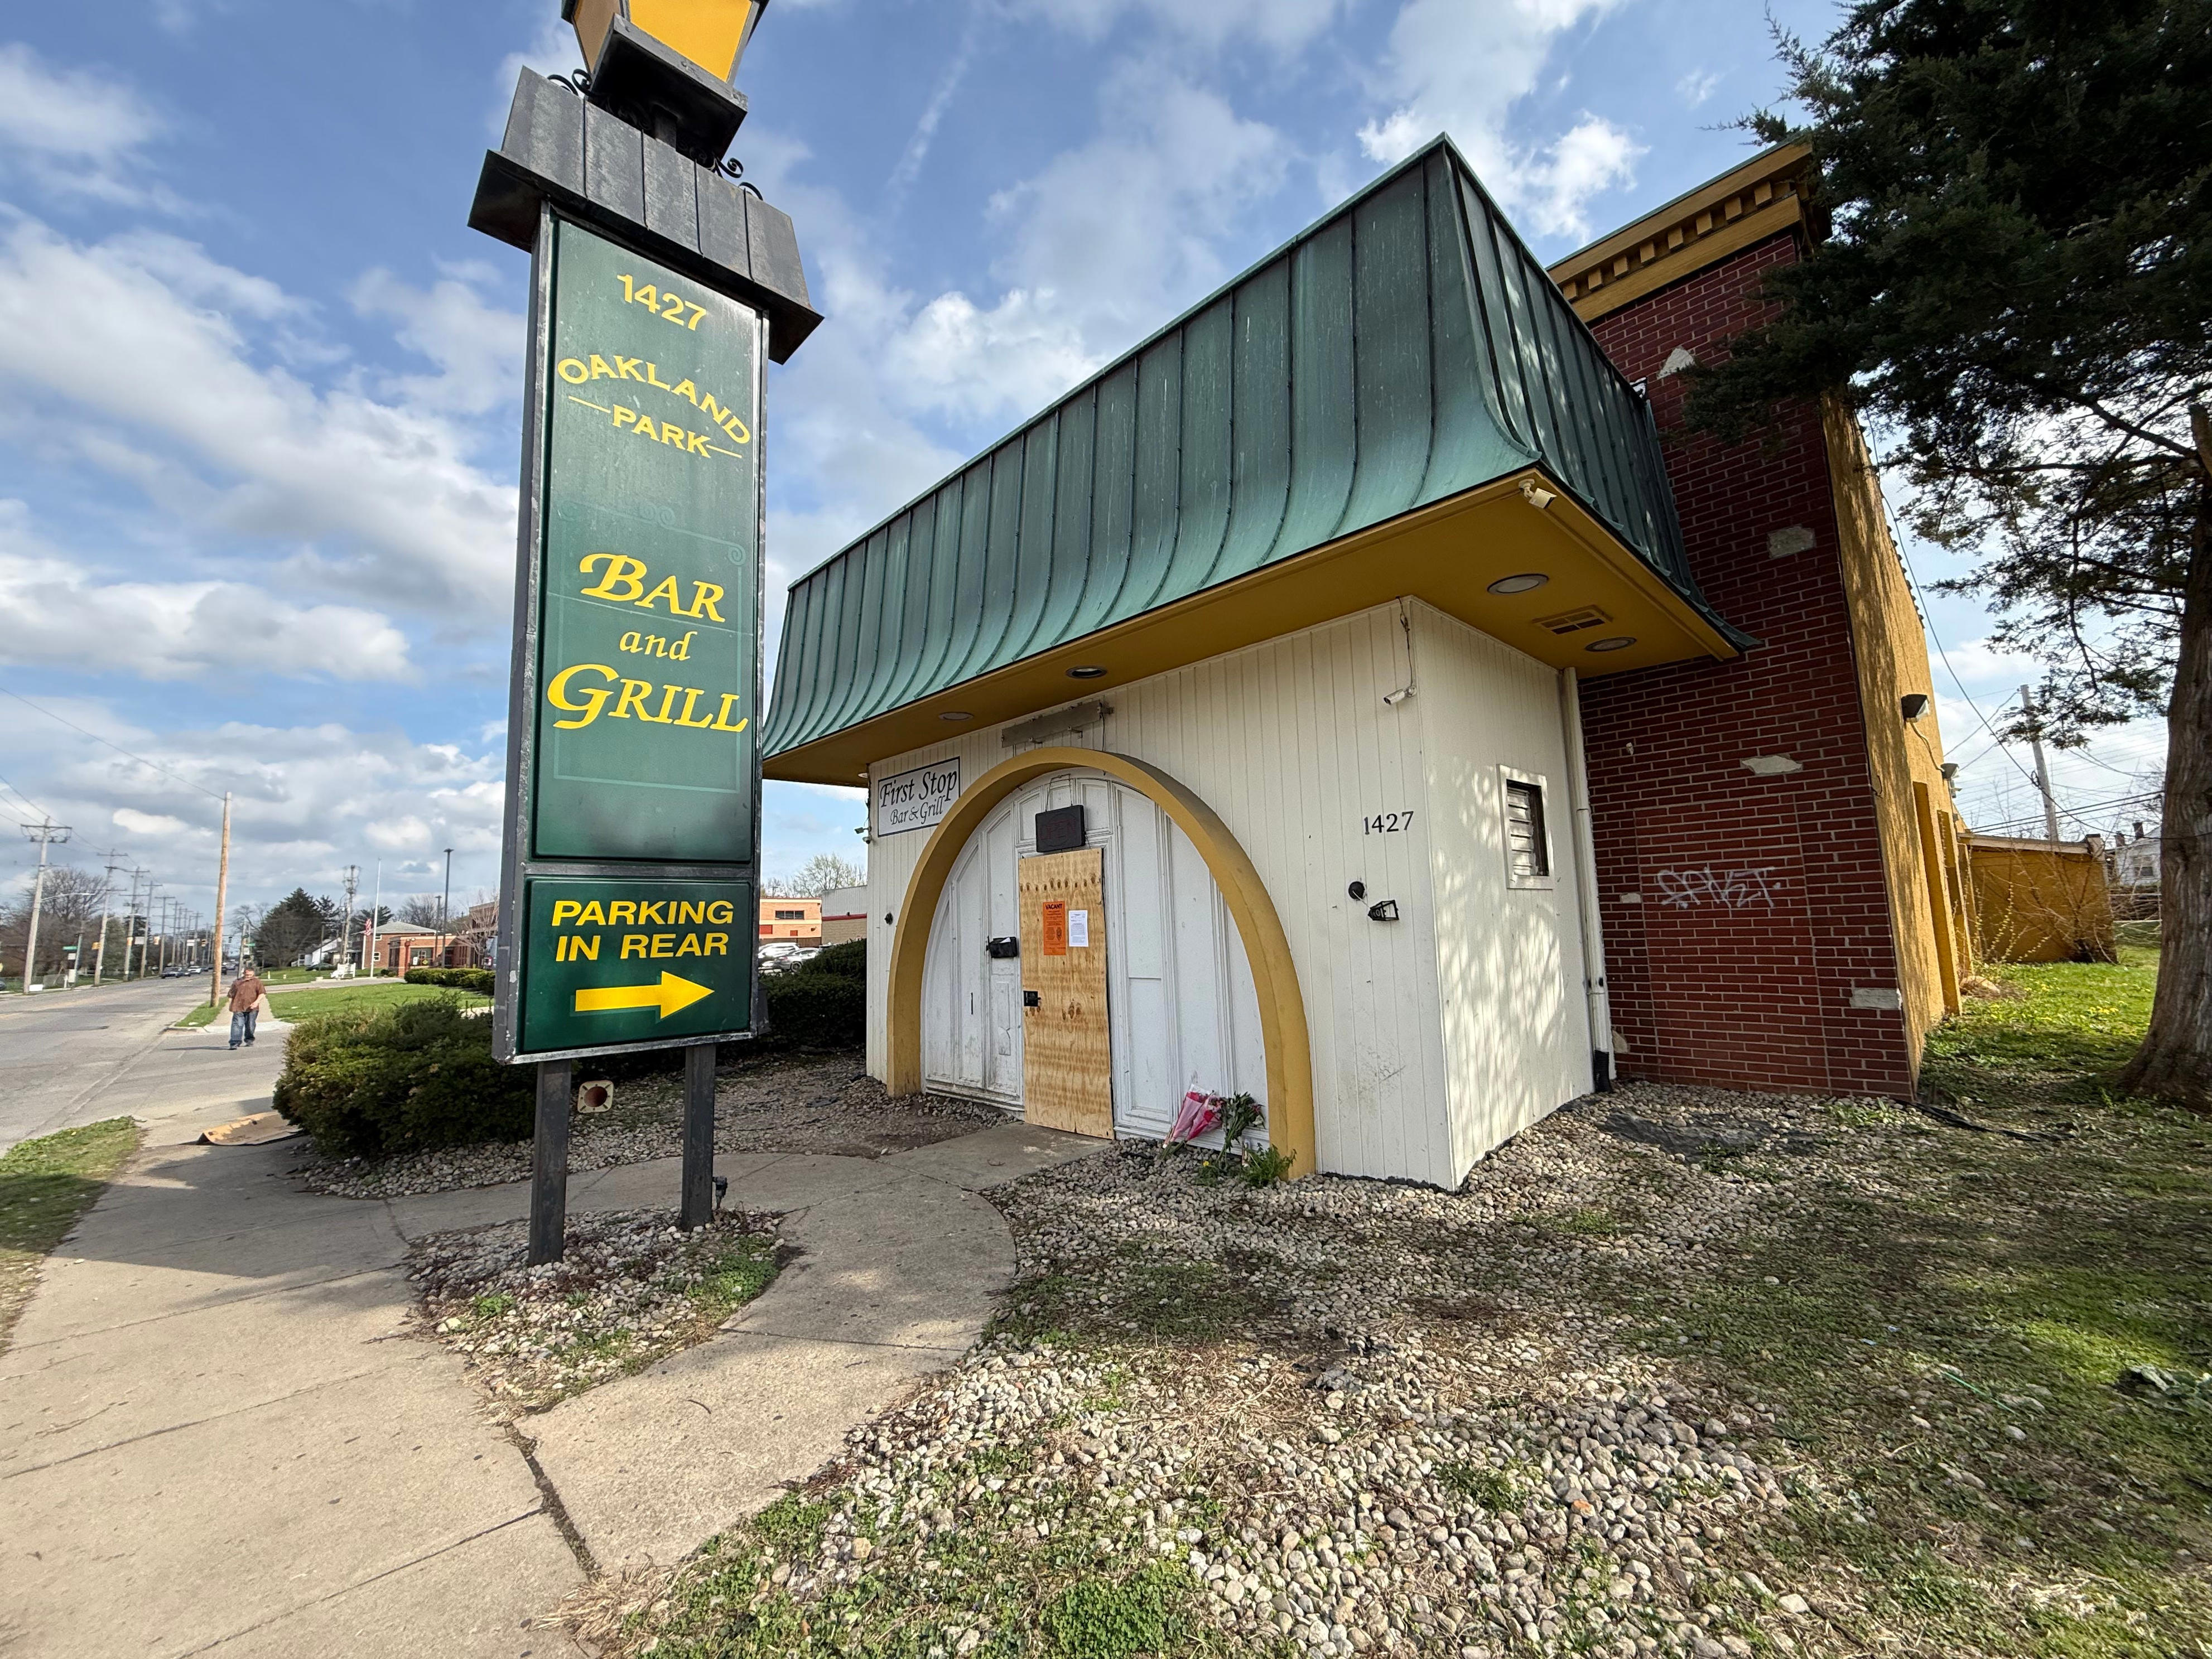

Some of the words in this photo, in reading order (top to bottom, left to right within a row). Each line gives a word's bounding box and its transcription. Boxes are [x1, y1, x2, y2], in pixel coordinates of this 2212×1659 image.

[617, 273, 706, 331] 1427
[558, 354, 750, 444] OAKLAND
[612, 404, 711, 458] PARK
[579, 553, 725, 623] BAR
[619, 631, 697, 661] and
[547, 664, 749, 732] GRILL
[880, 779, 914, 808] First
[918, 770, 957, 802] Stop
[890, 809, 908, 825] Bar
[920, 795, 946, 824] Grill
[1364, 811, 1414, 835] 1427
[551, 900, 734, 926] PARKING
[556, 935, 601, 962] IN
[620, 932, 729, 959] REAR
